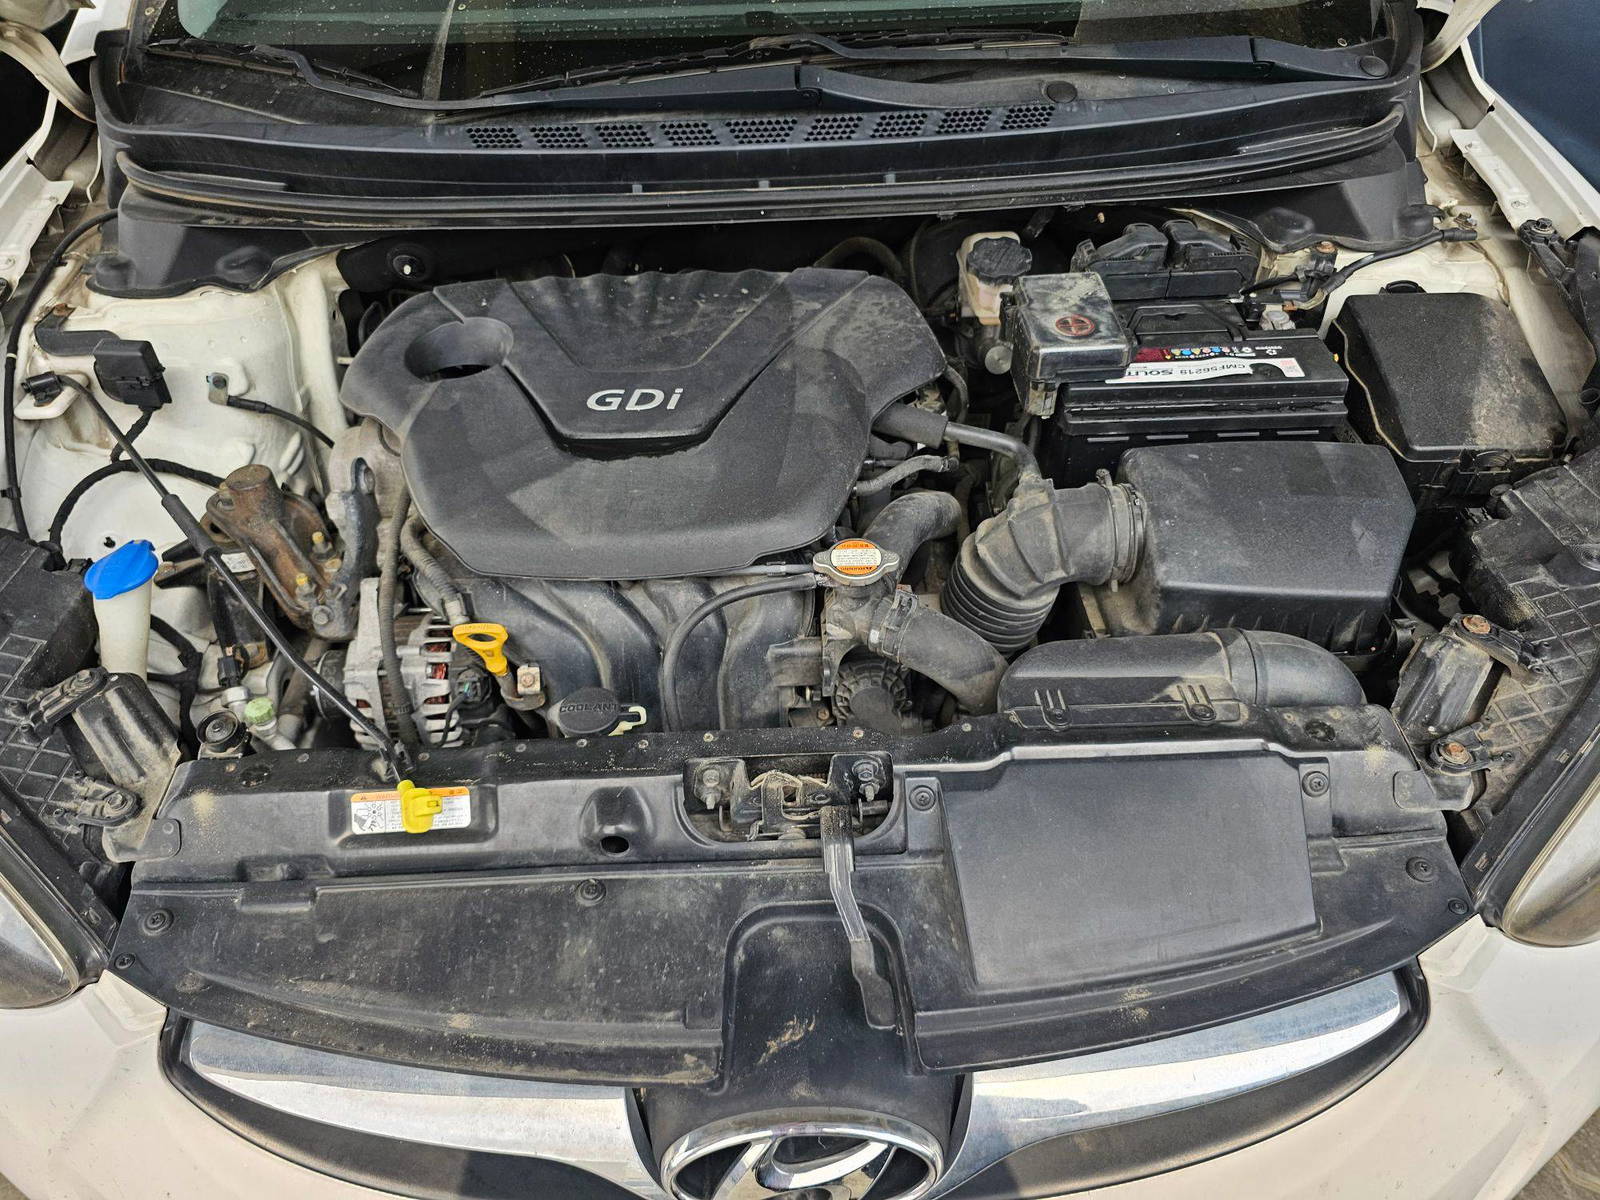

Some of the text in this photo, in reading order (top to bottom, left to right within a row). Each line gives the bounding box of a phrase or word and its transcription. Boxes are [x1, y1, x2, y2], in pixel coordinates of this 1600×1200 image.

[1127, 368, 1173, 376] SOLIT
[586, 388, 684, 411] GDi
[559, 703, 618, 713] COOLANT
